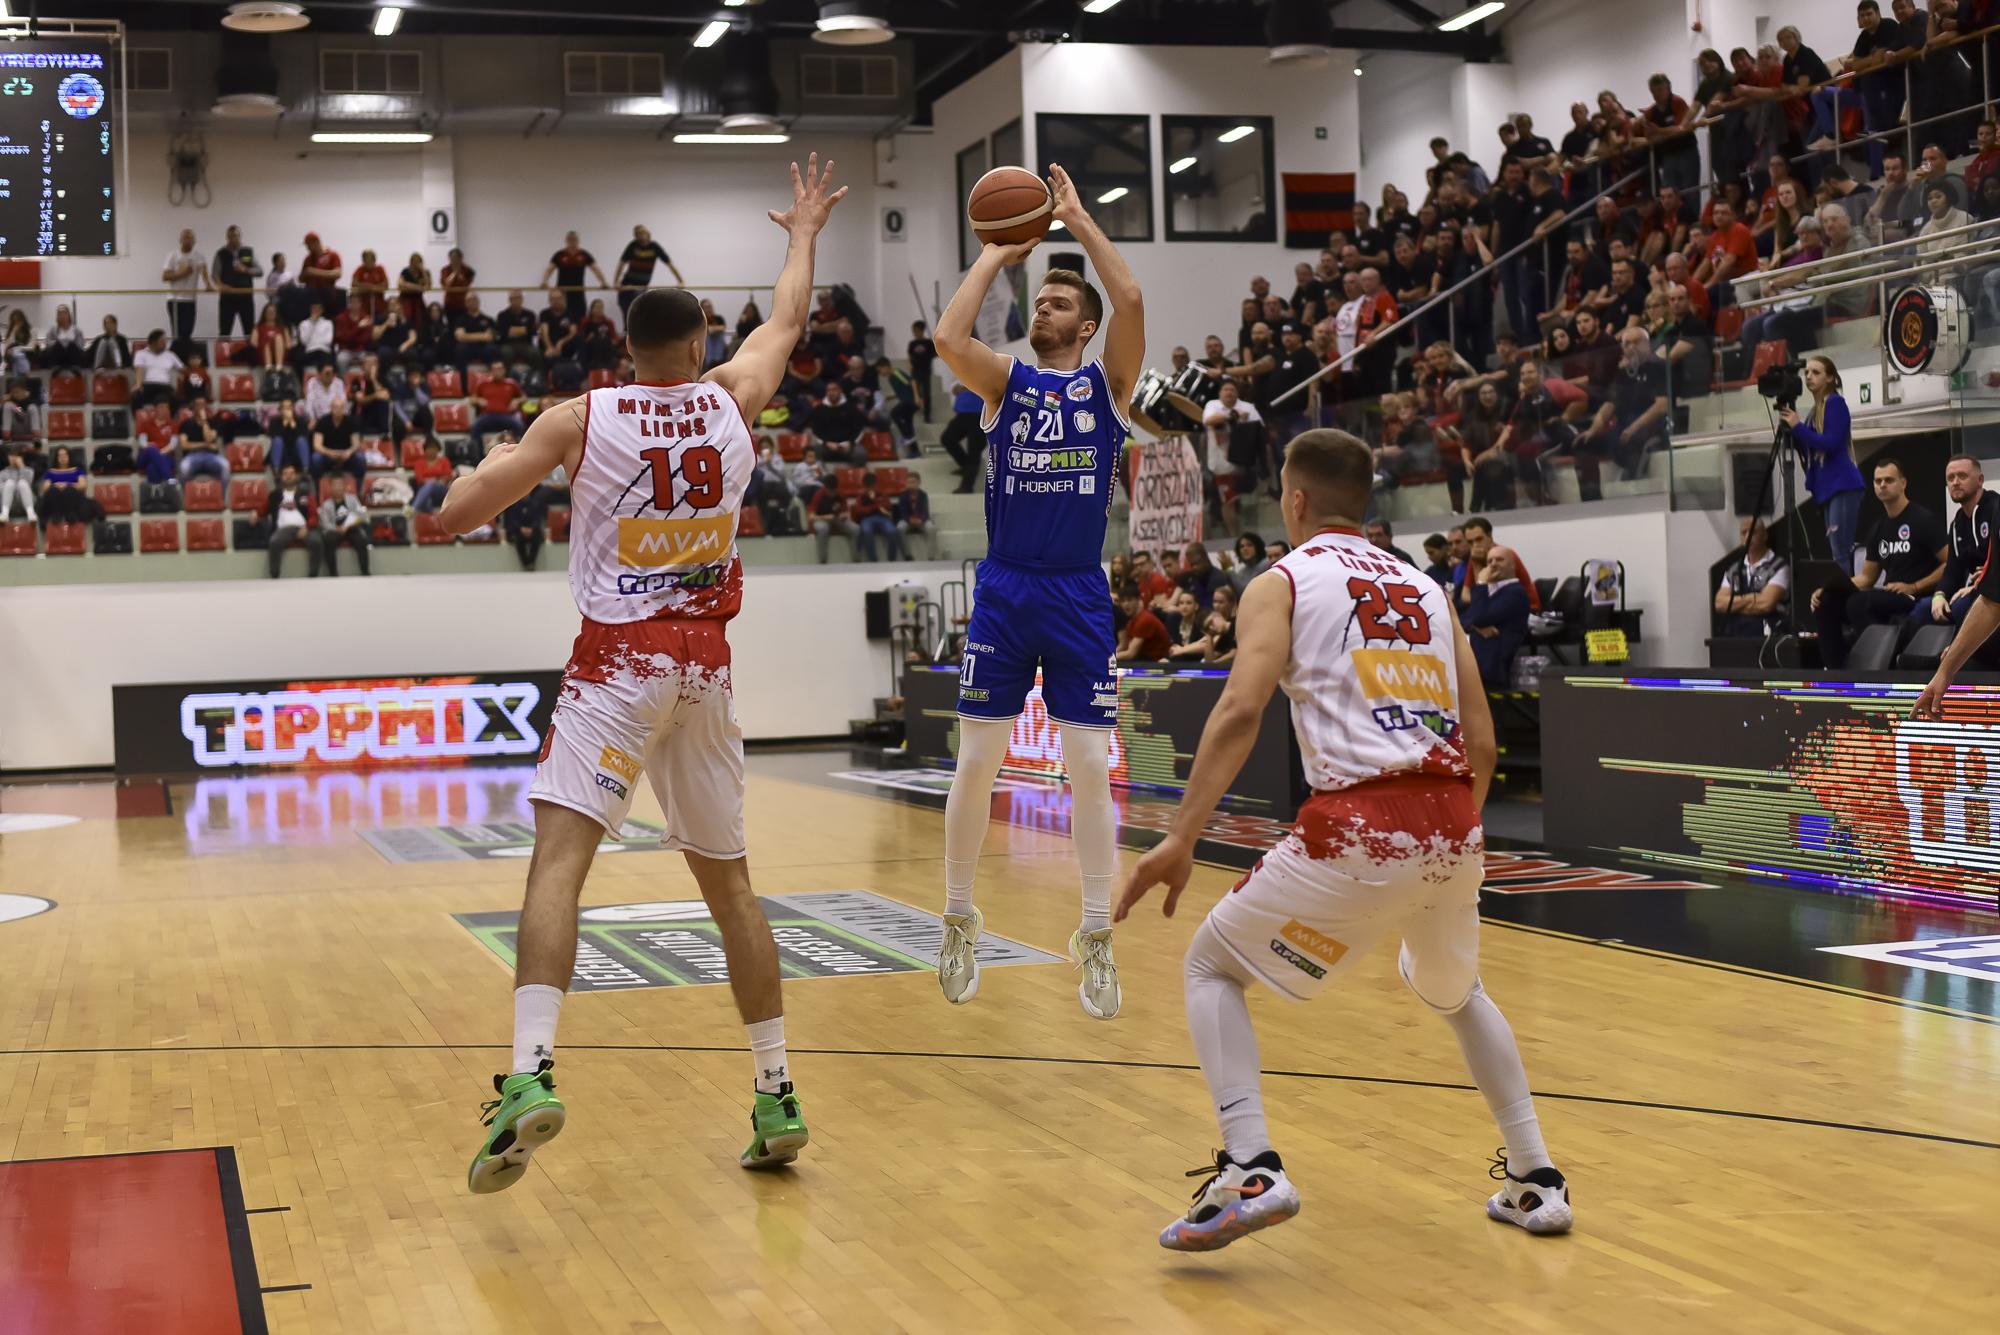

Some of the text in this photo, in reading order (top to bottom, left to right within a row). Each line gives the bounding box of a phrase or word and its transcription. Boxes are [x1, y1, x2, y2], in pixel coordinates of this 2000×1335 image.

[432, 210, 449, 234] 0
[886, 210, 903, 233] 0
[640, 417, 707, 438] LIONS
[1034, 409, 1064, 442] 20
[640, 445, 724, 511] 19
[1020, 480, 1074, 493] HÜBNER
[638, 529, 720, 554] MVM
[1337, 554, 1402, 577] LIONS
[1346, 576, 1432, 645] 25
[1376, 663, 1443, 693] MVM
[1291, 928, 1335, 957] MVM
